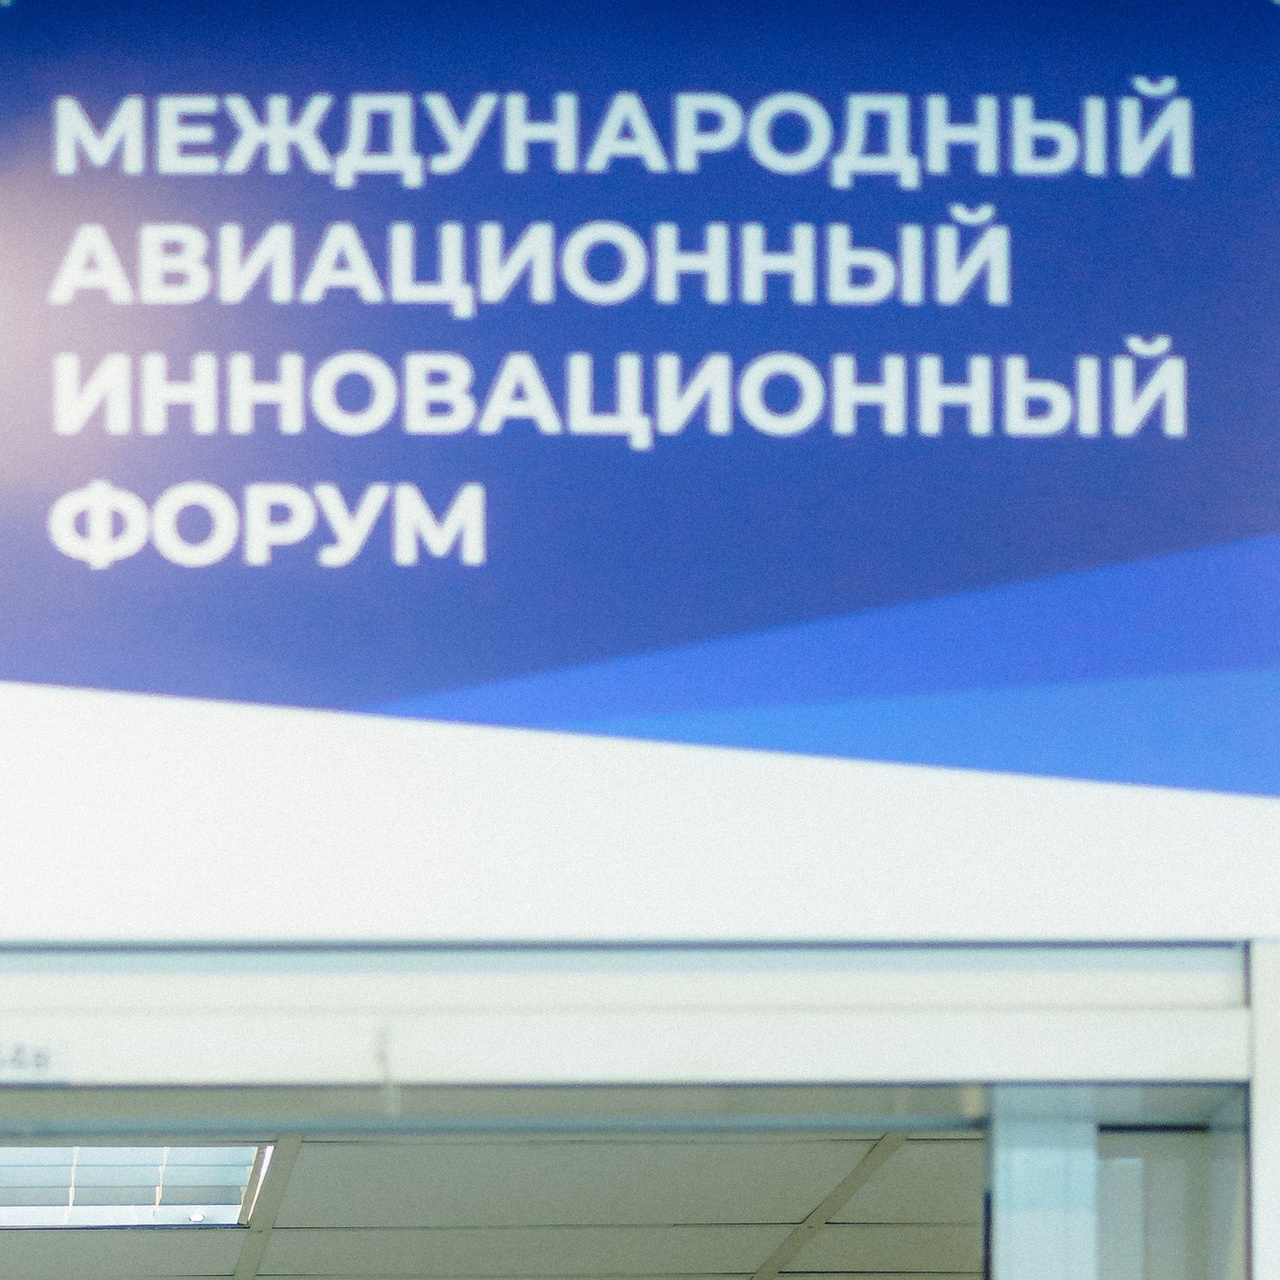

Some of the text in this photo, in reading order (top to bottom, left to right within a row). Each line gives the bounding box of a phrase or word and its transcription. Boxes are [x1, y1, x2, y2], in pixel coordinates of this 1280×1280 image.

[53, 75, 1195, 190] МЕЖДУНАРОДНЫЙ
[47, 204, 1011, 319] АВИАЦИОННЫЙ
[51, 335, 1188, 450] ИННОВАЦИОННЫЙ
[47, 478, 487, 570] ФОРУМ
